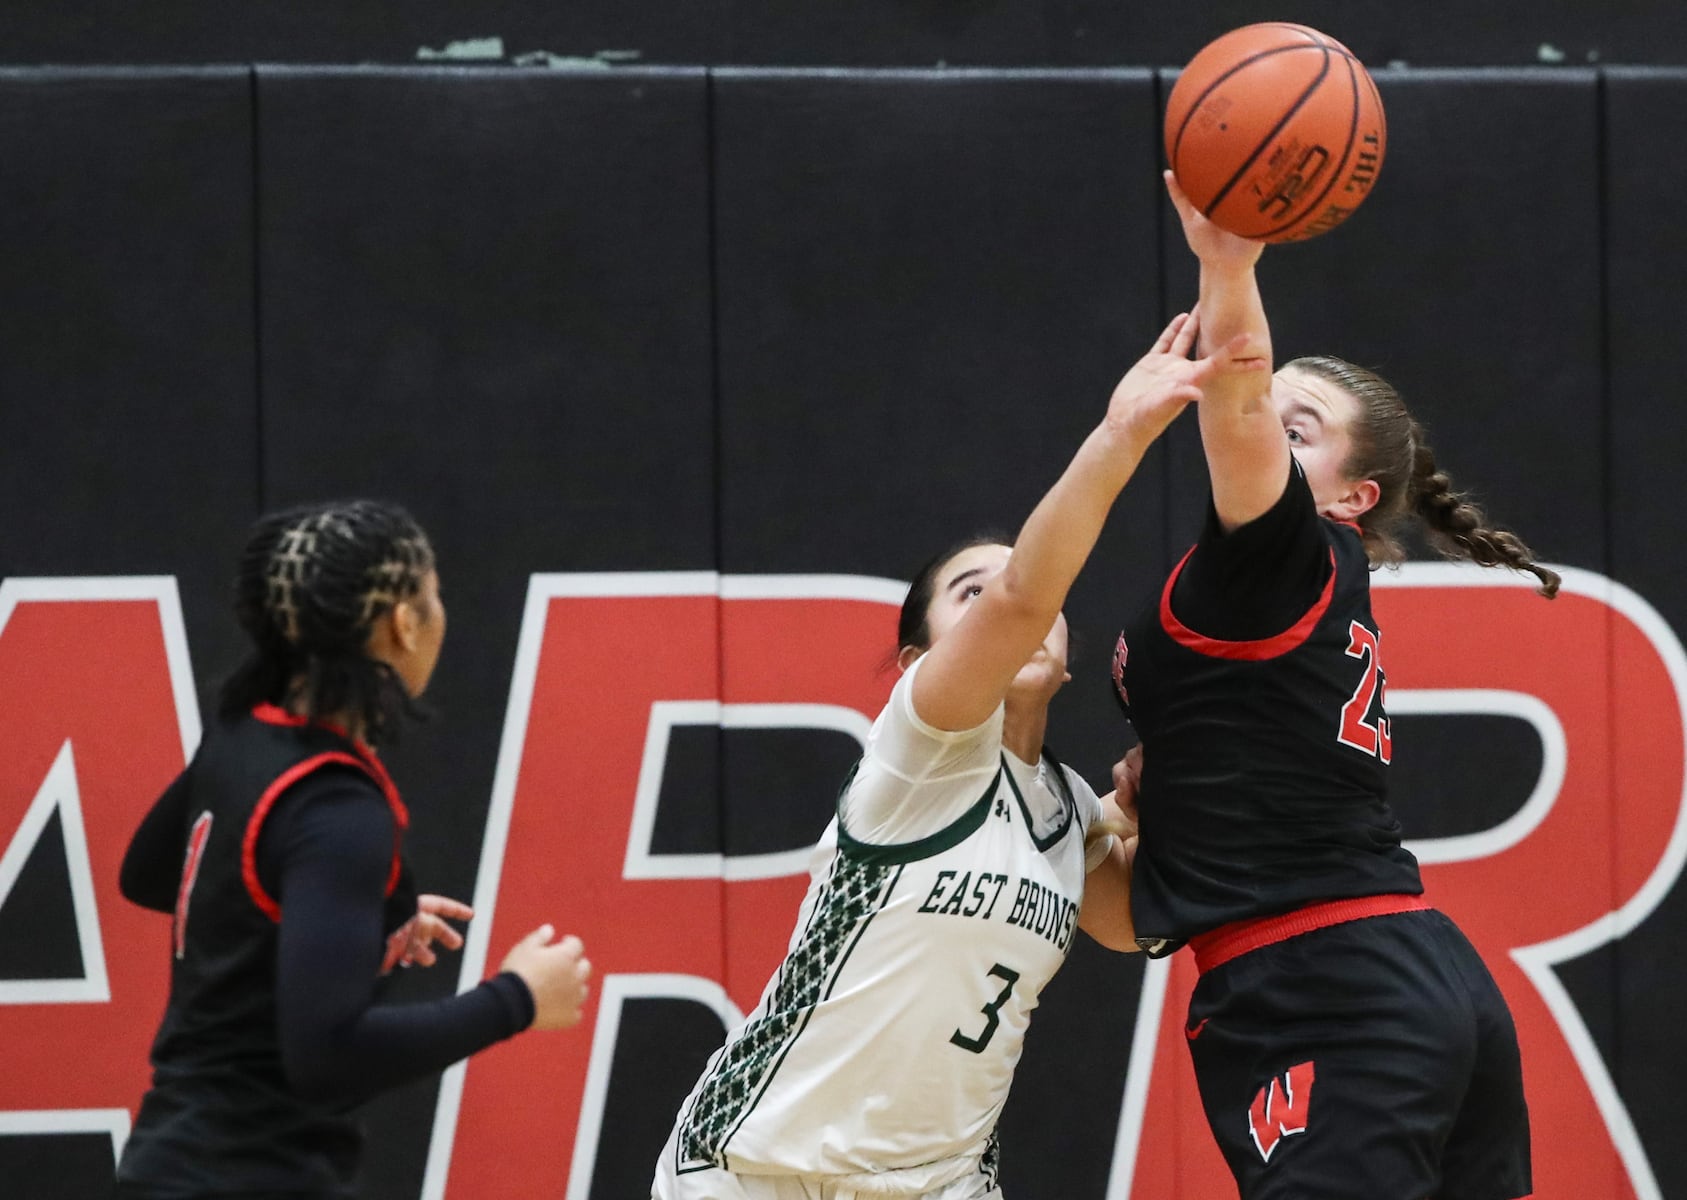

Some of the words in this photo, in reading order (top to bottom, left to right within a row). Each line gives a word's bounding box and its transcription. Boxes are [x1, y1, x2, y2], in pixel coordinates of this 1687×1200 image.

[1337, 619, 1392, 765] 2
[917, 870, 1009, 920] EAST
[1006, 877, 1080, 955] BRUNS
[949, 963, 1021, 1054] 3
[1247, 1060, 1315, 1163] W
